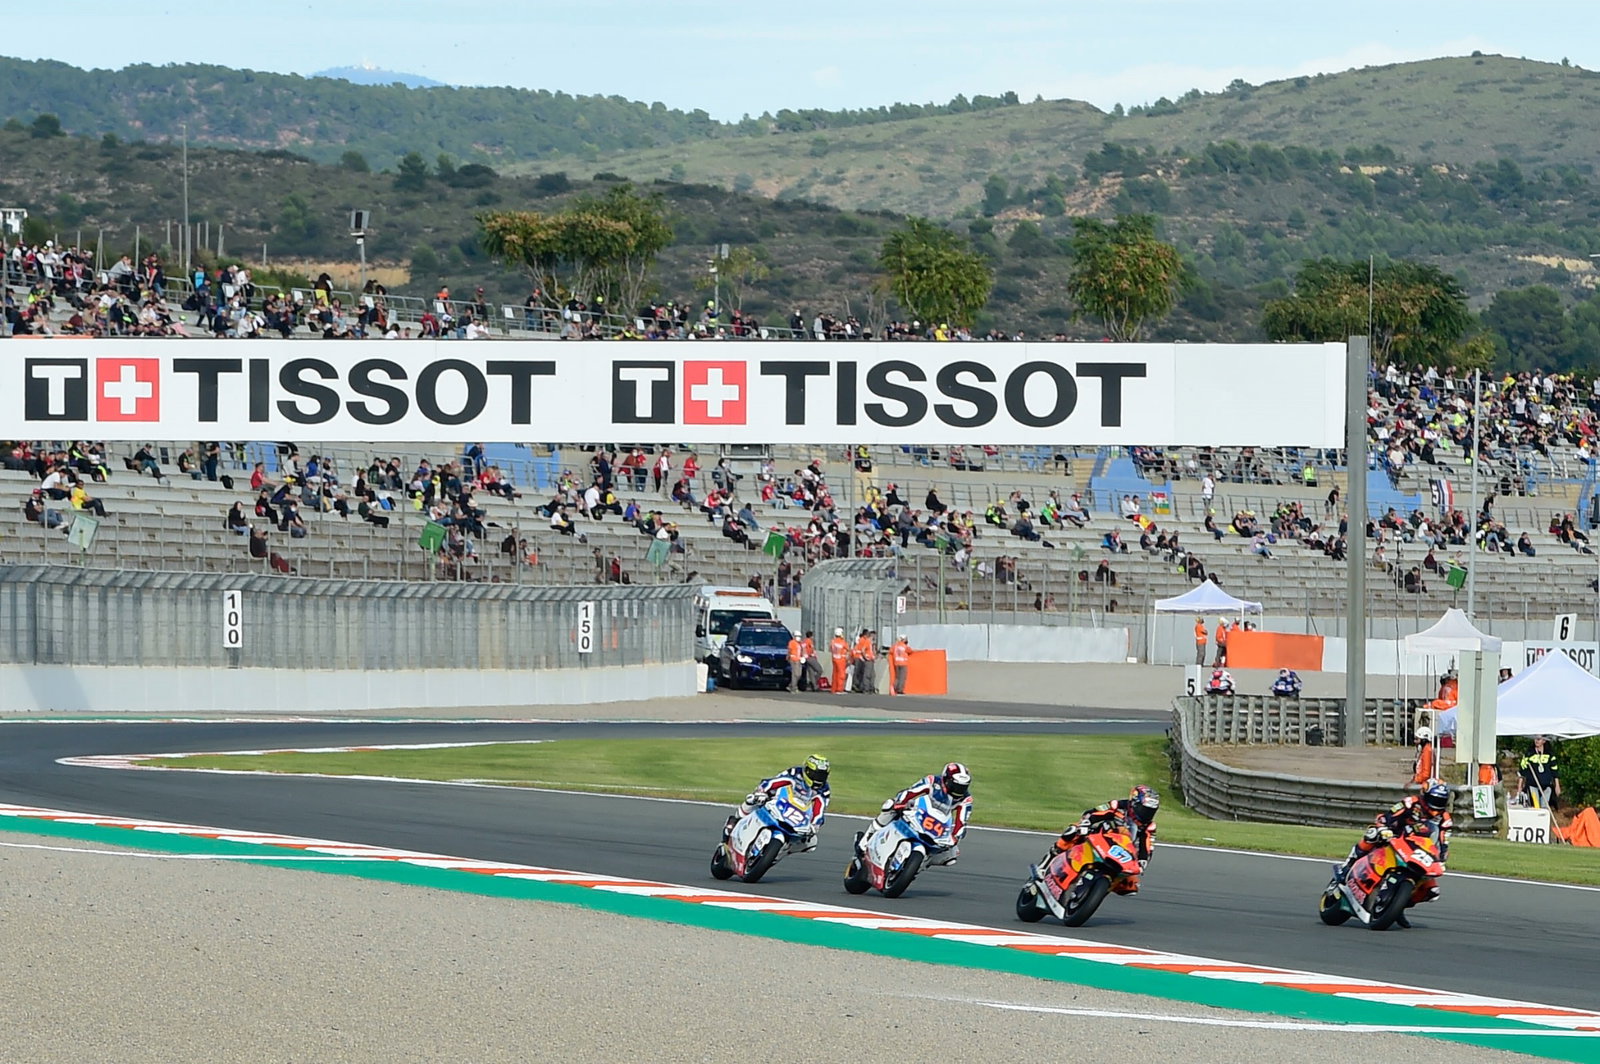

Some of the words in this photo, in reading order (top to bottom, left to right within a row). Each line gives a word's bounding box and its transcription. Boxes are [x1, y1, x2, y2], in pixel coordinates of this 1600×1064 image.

[173, 358, 556, 425] TISSOT
[761, 361, 1147, 427] TISSOT
[227, 593, 239, 644] 100
[581, 604, 590, 650] 150
[1559, 616, 1570, 641] 6
[1187, 679, 1196, 697] 5
[783, 806, 805, 825] 12
[922, 816, 944, 837] 64
[1411, 848, 1435, 868] 25
